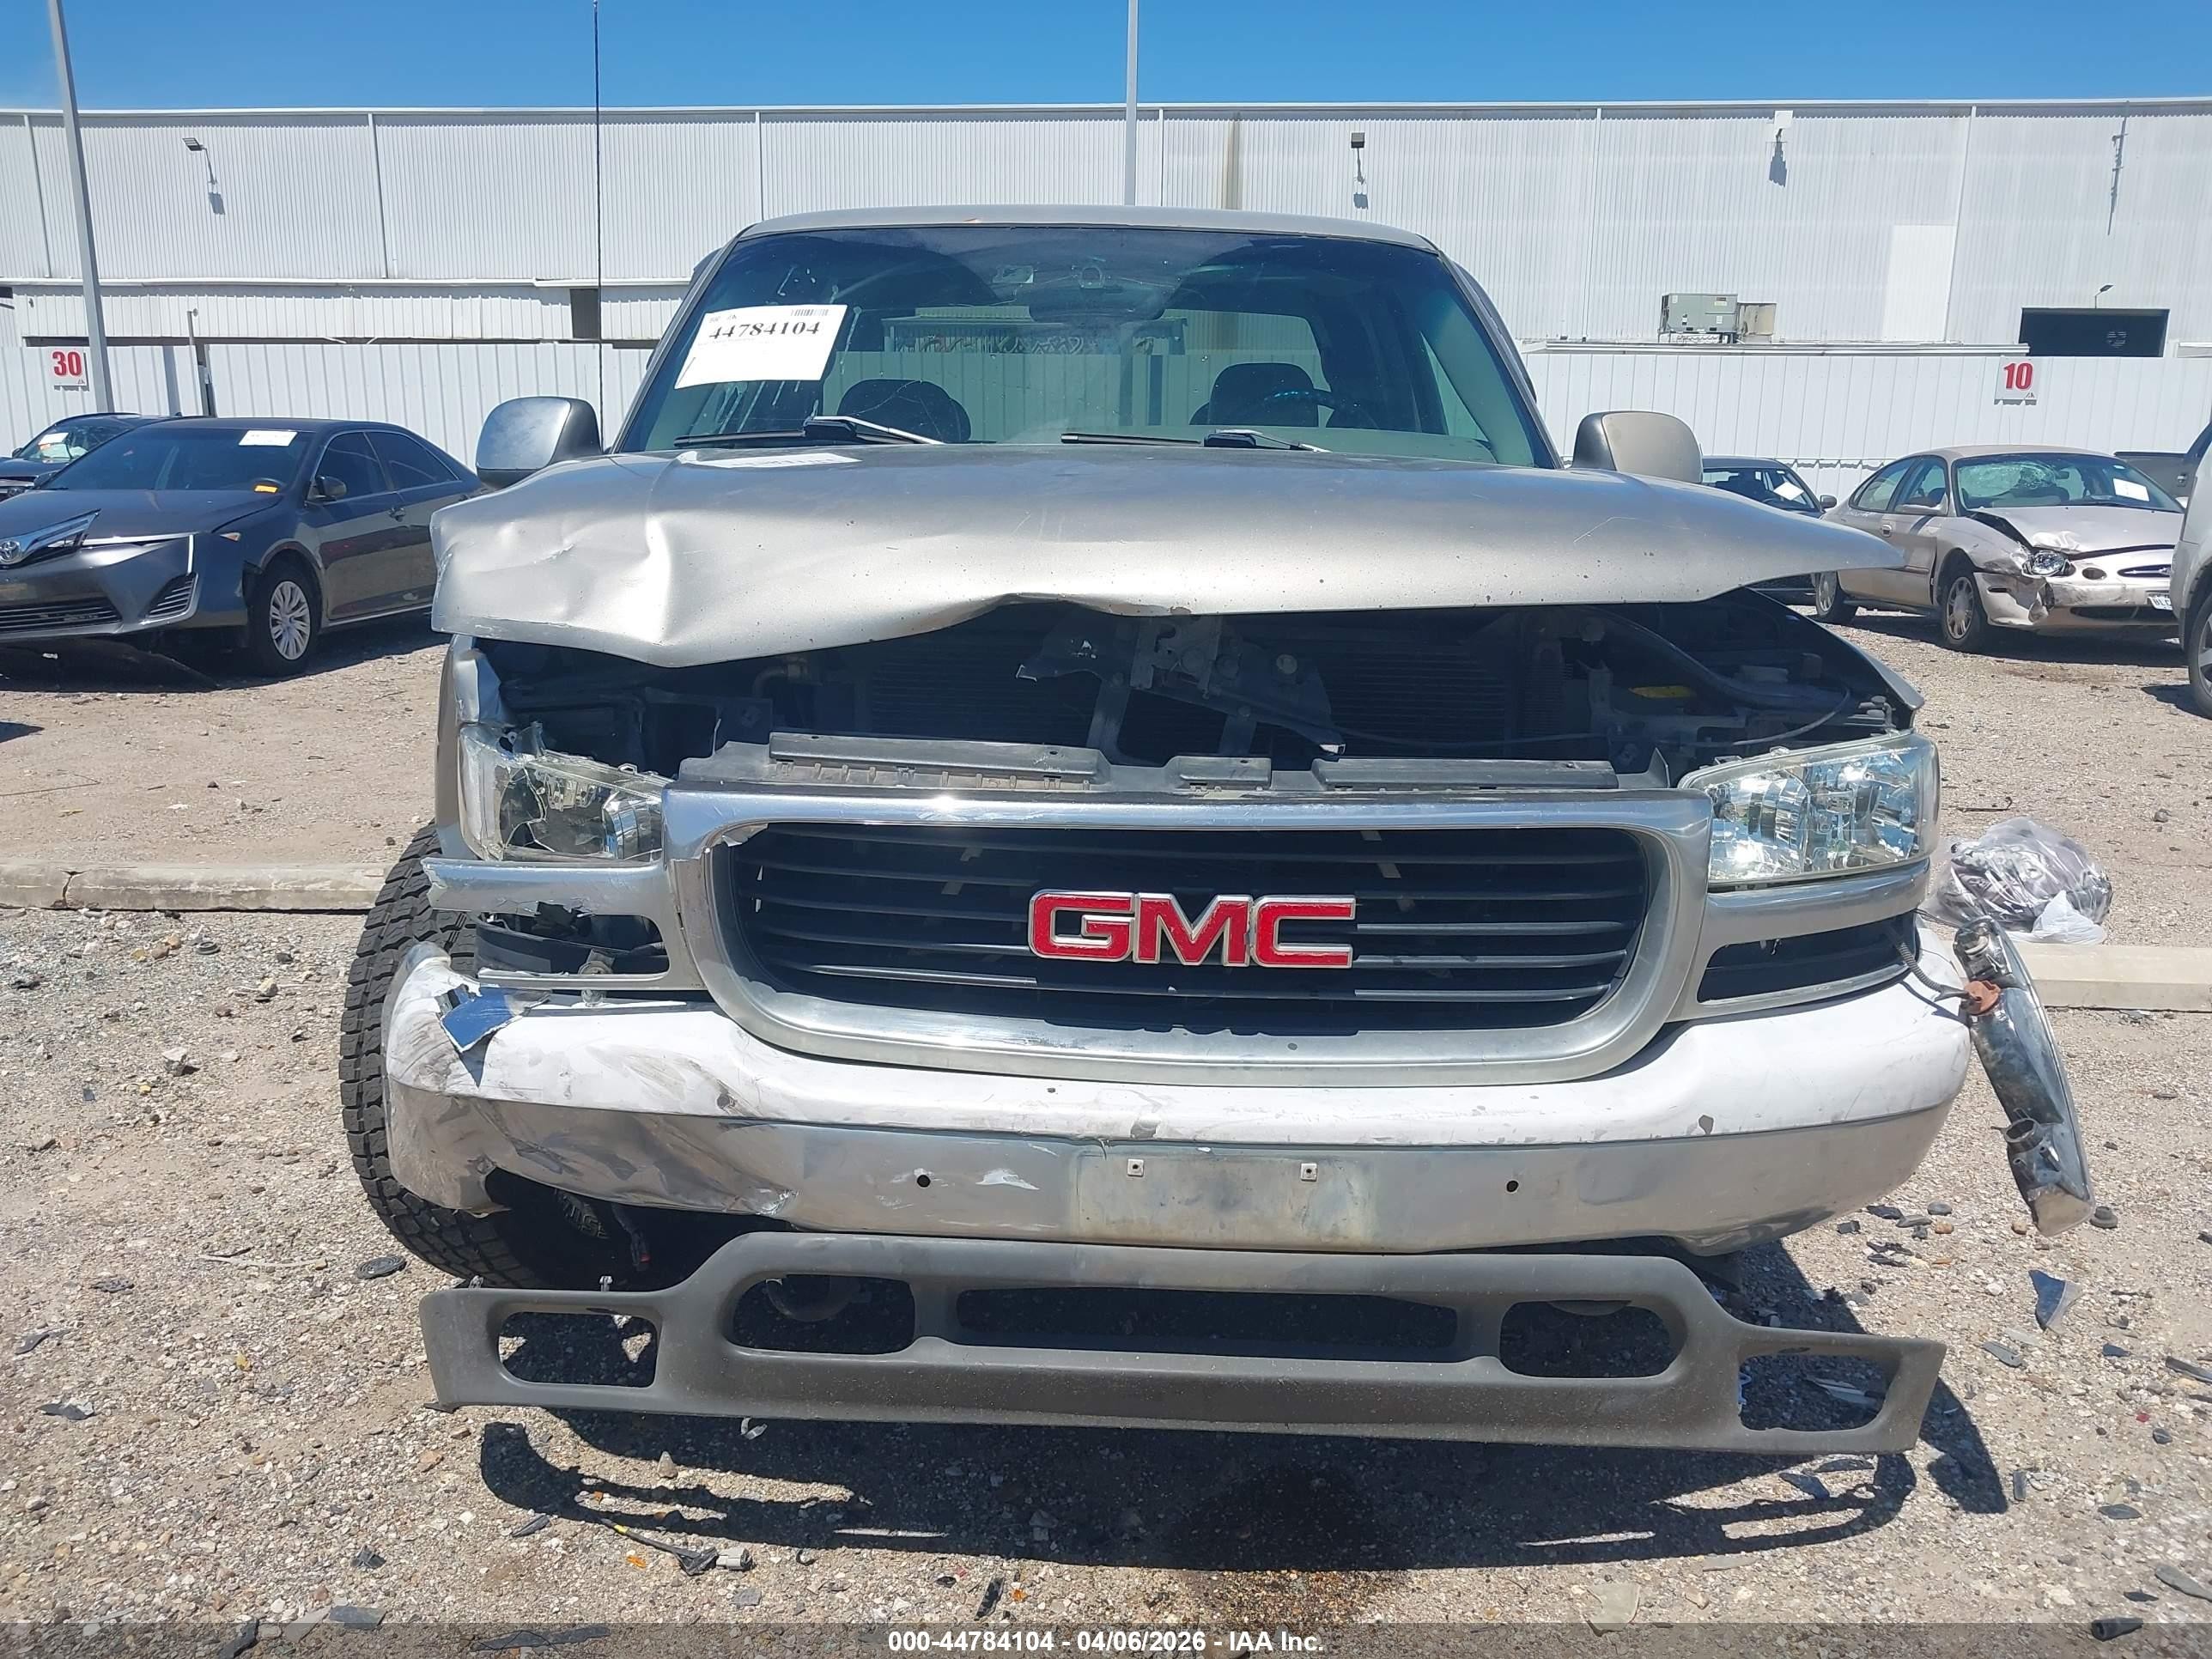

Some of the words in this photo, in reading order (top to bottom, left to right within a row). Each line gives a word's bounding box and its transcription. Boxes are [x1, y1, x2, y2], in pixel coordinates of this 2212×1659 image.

[708, 321, 821, 339] 44784104
[52, 350, 82, 376] 30
[2003, 362, 2033, 390] 10
[1028, 889, 1357, 969] GMC
